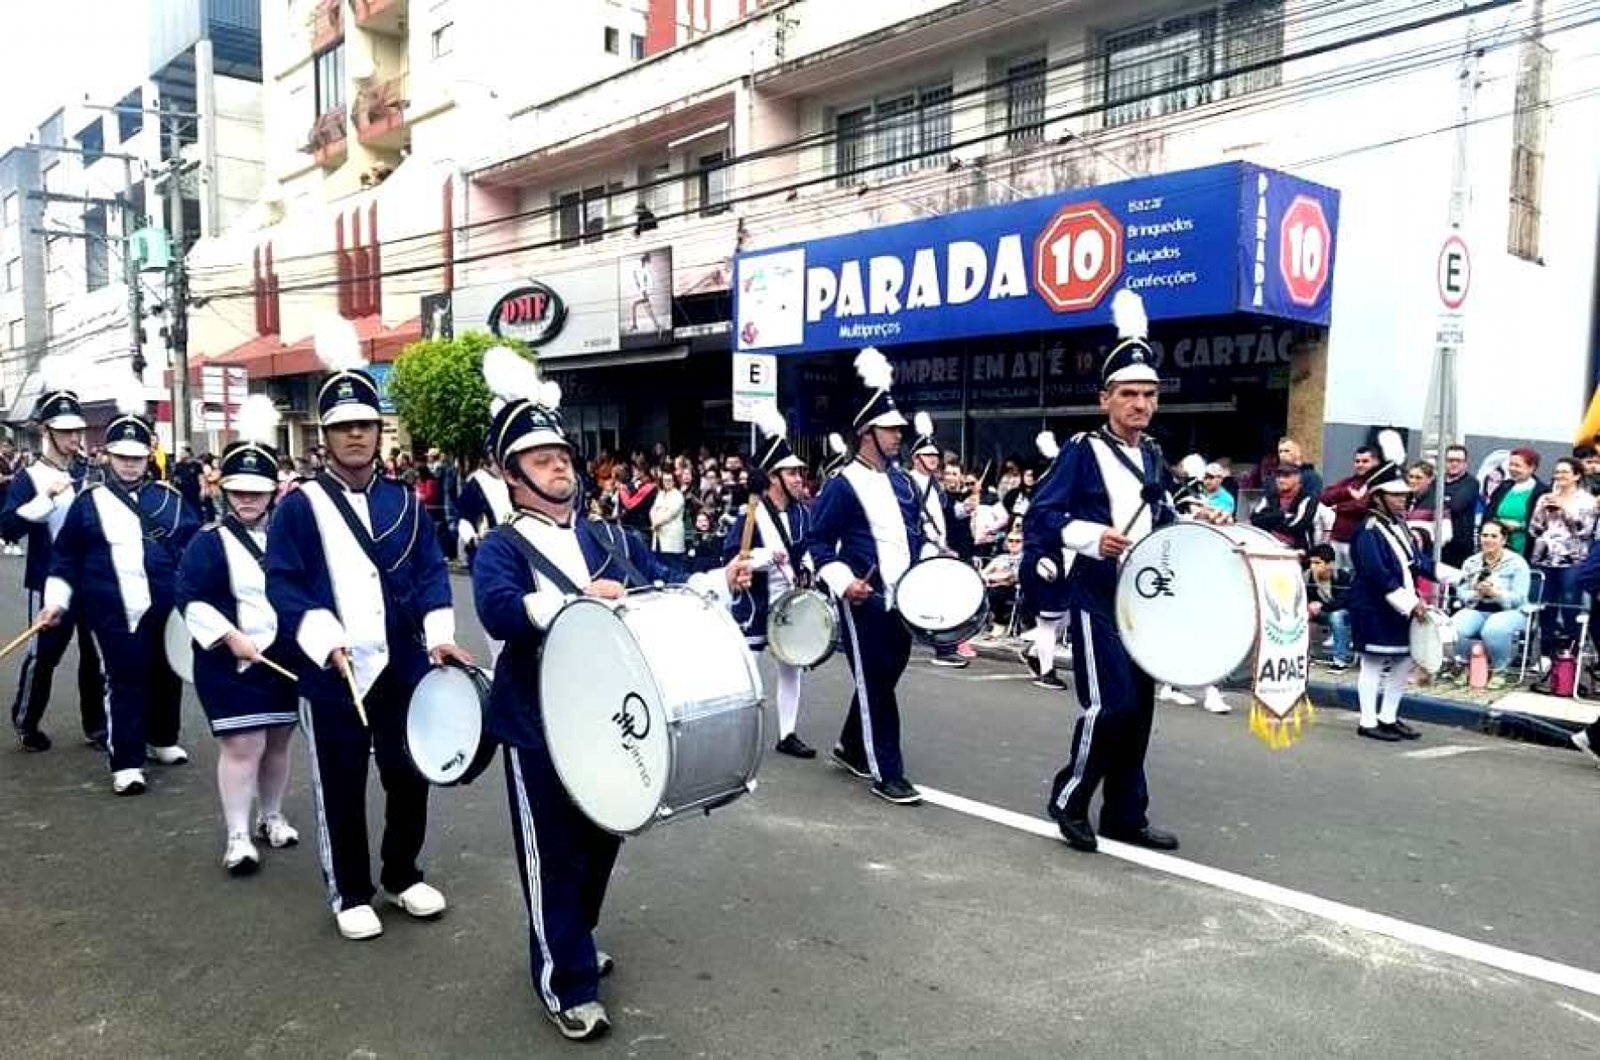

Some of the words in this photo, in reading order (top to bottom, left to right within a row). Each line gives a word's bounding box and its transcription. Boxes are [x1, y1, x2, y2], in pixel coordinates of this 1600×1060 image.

[1128, 196, 1164, 213] Bazar
[1127, 217, 1194, 238] Brinquedos
[1253, 172, 1269, 306] PARADA
[1127, 246, 1181, 266] Calçados
[1288, 222, 1321, 282] 10
[806, 234, 1028, 323] PARADA
[1051, 228, 1105, 286] 10
[1126, 270, 1197, 289] Confecções
[1446, 252, 1461, 292] E
[839, 321, 902, 339] Multipreços
[749, 363, 761, 384] E
[973, 353, 1006, 381] EM
[1259, 655, 1305, 682] APAE
